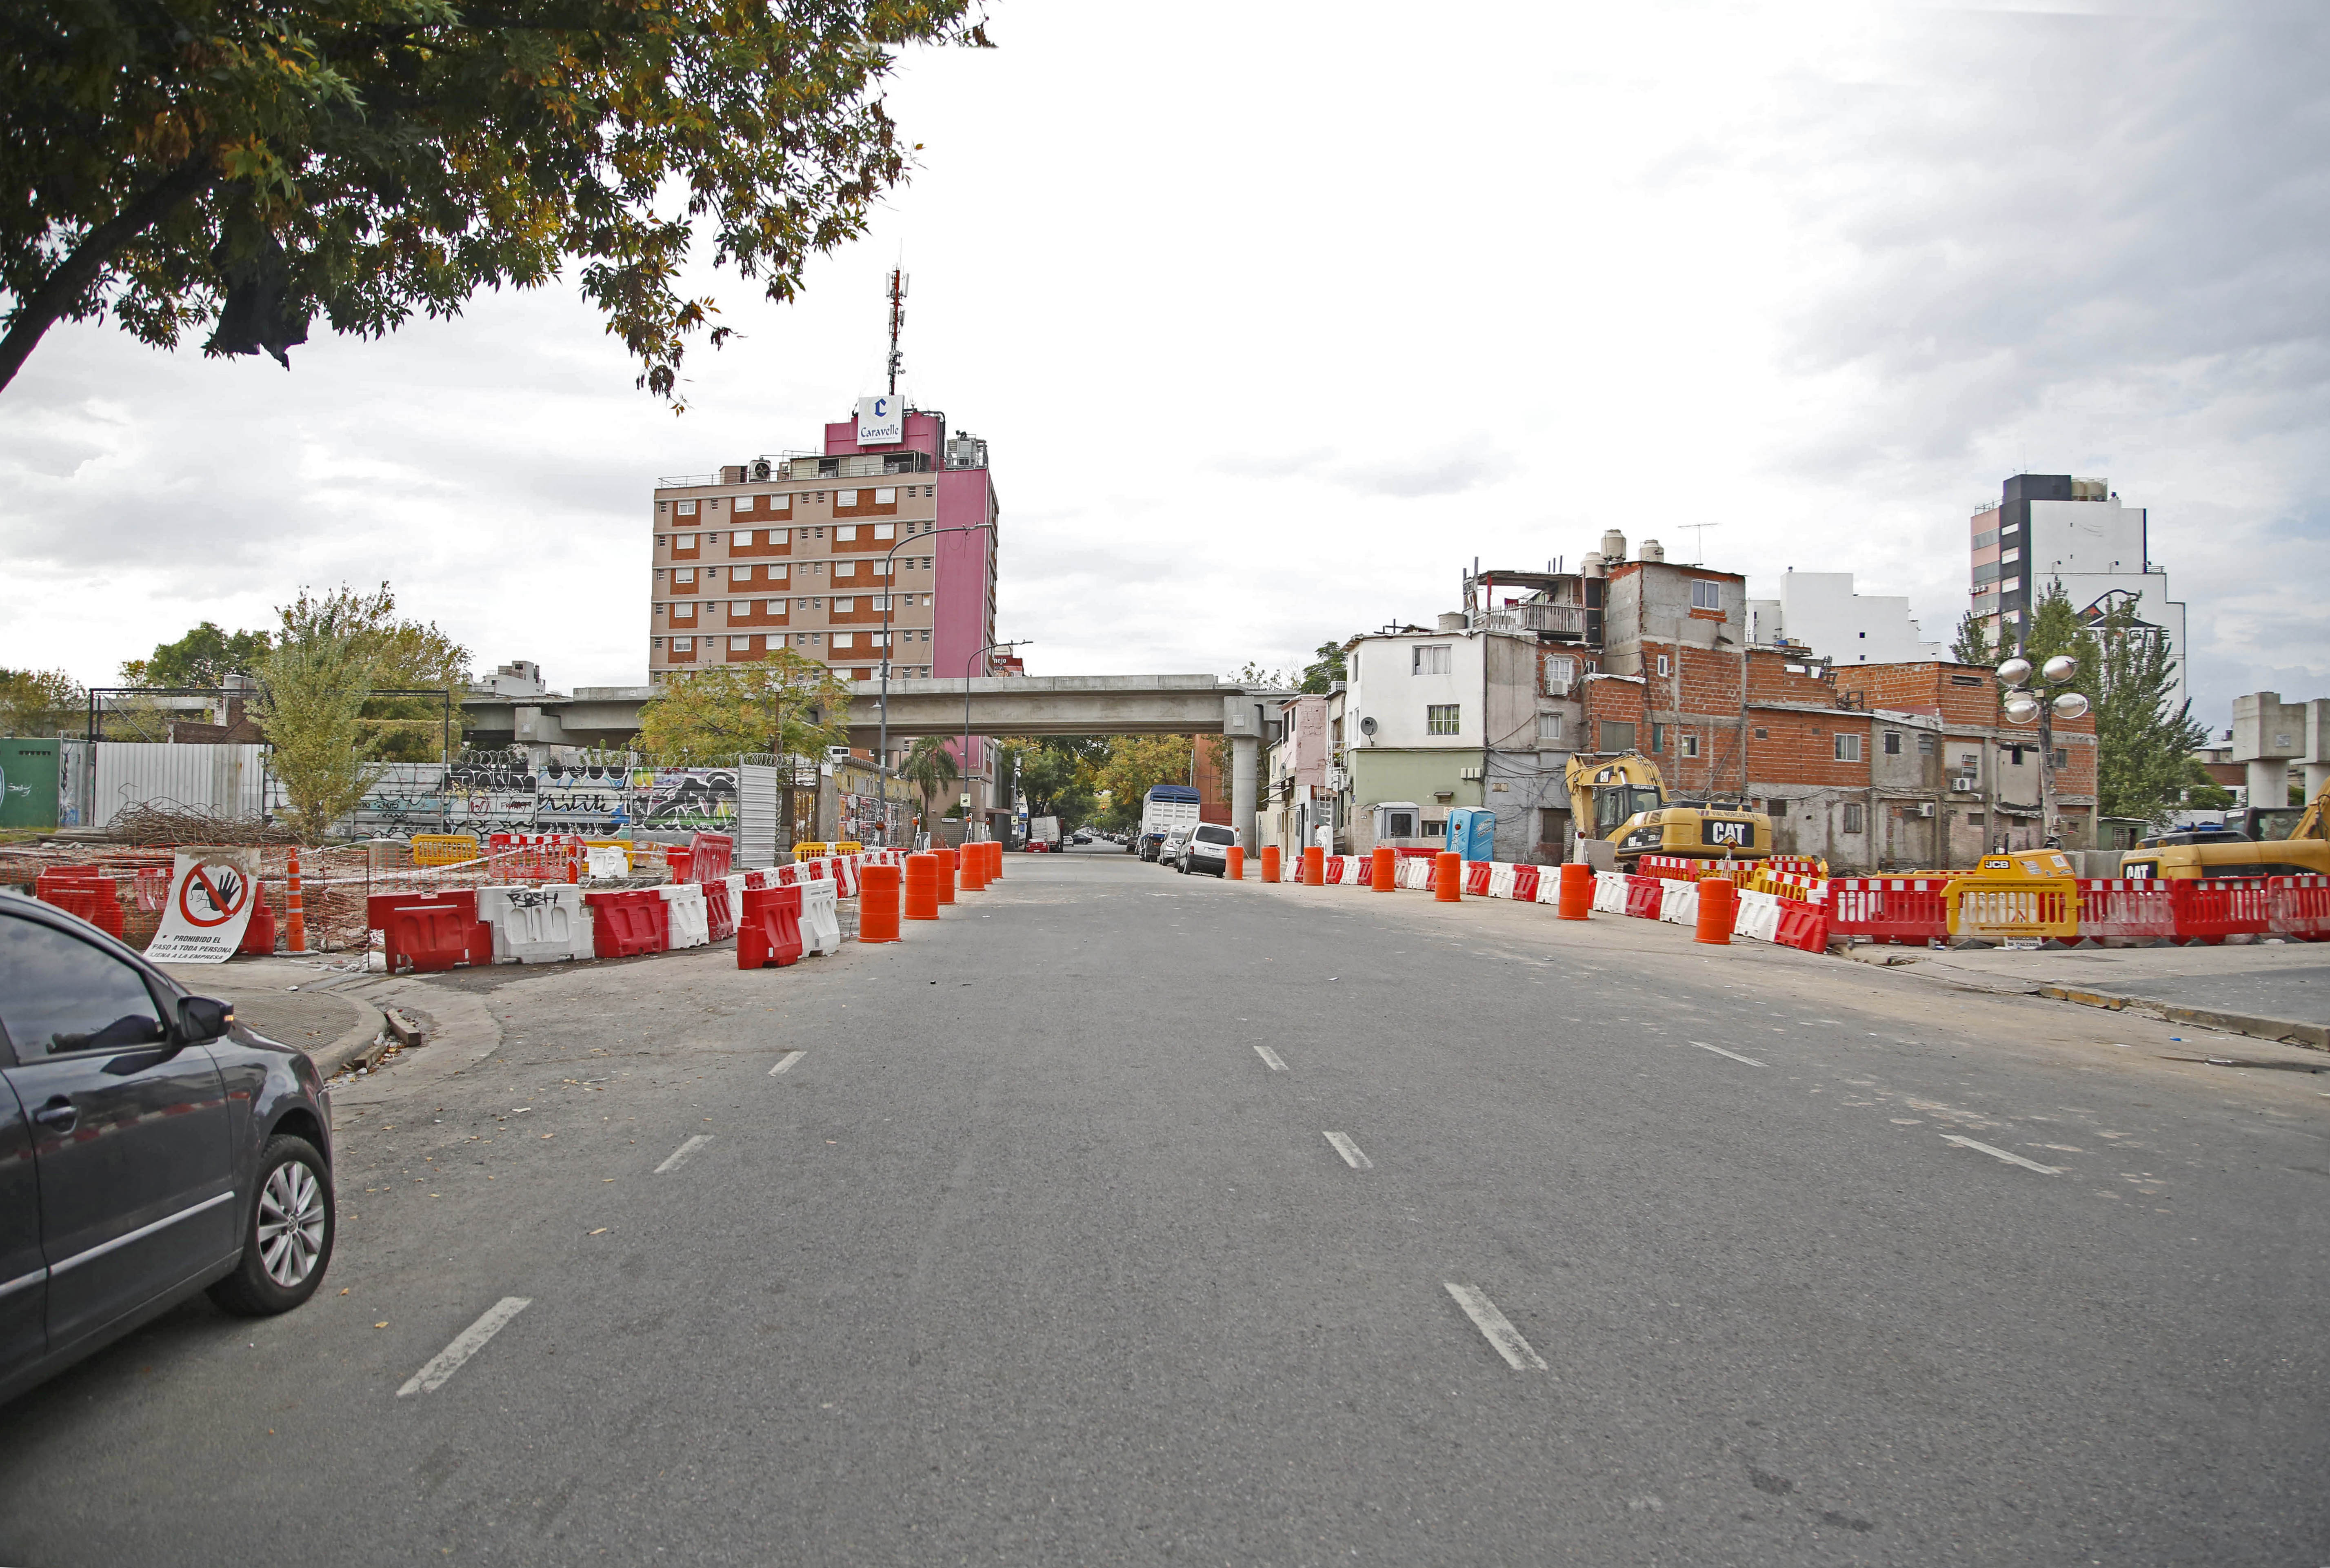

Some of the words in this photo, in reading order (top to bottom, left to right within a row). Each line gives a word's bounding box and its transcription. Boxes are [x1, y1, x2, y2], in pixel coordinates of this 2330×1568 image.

[861, 424, 899, 437] Caravelle
[1600, 771, 1609, 783] CAT
[1713, 822, 1745, 845] CAT
